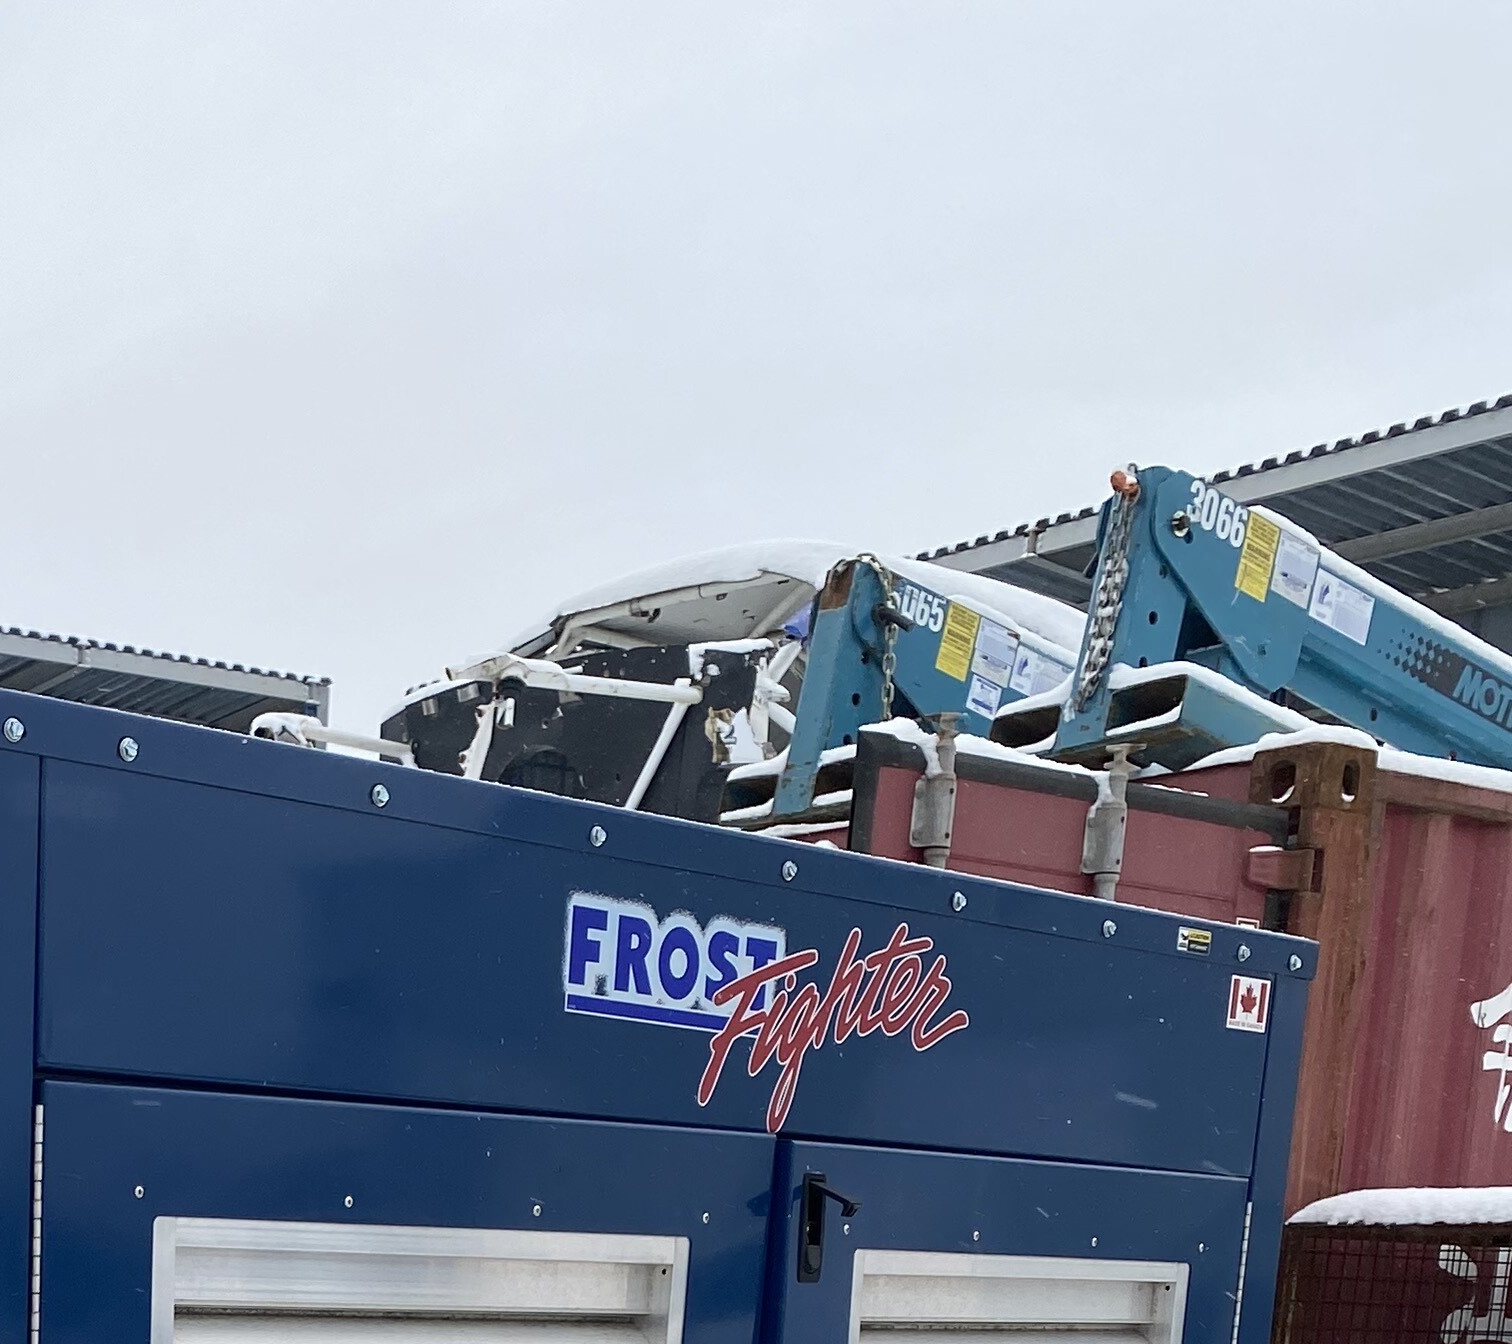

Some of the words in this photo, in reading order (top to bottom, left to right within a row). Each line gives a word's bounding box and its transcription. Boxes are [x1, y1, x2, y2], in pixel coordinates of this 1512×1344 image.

[1186, 480, 1248, 548] 3066
[900, 584, 946, 633] 065
[1453, 664, 1512, 728] MOT
[567, 905, 778, 1009] FROST
[697, 921, 969, 1135] Fighter
